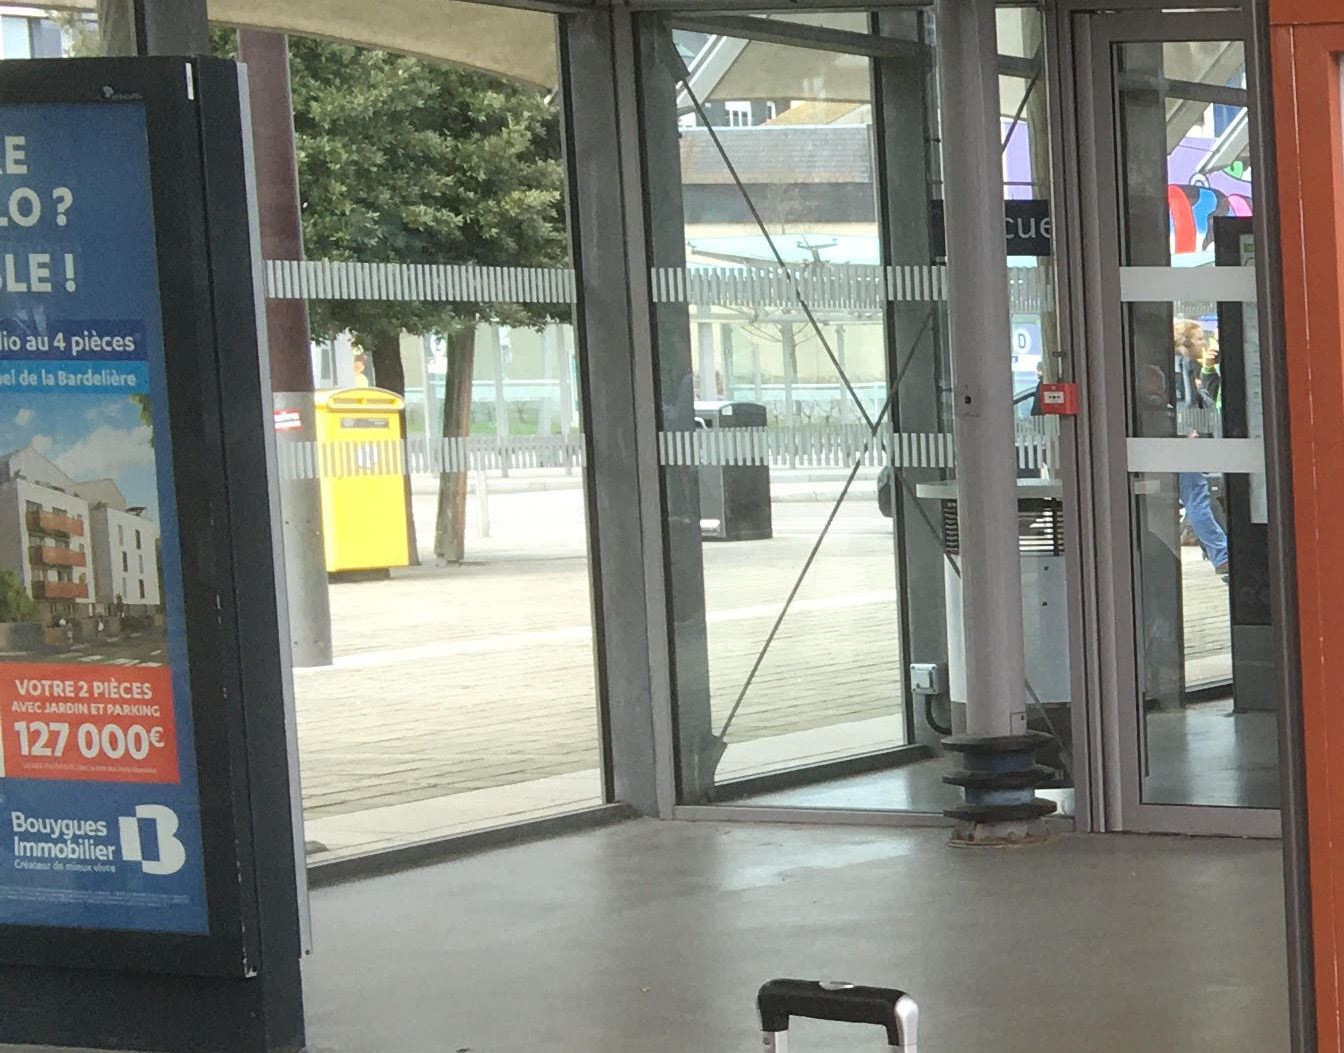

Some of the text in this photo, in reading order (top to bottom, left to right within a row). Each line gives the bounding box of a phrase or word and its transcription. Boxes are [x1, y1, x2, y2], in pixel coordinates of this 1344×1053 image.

[0, 136, 27, 174] E
[53, 187, 73, 226] ?
[0, 254, 76, 292] LE !
[0, 330, 135, 356] io au 4 pièces
[1018, 333, 1026, 349] D
[19, 370, 38, 386] de
[42, 370, 55, 385] la
[58, 369, 136, 386] Bardelière
[15, 678, 152, 699] VOTRE 2 PIÈCES
[11, 701, 160, 717] AVEC JARDIN ET PARKING
[14, 721, 69, 756] 127
[11, 811, 108, 839] Bouygues
[14, 836, 116, 860] Immobilier
